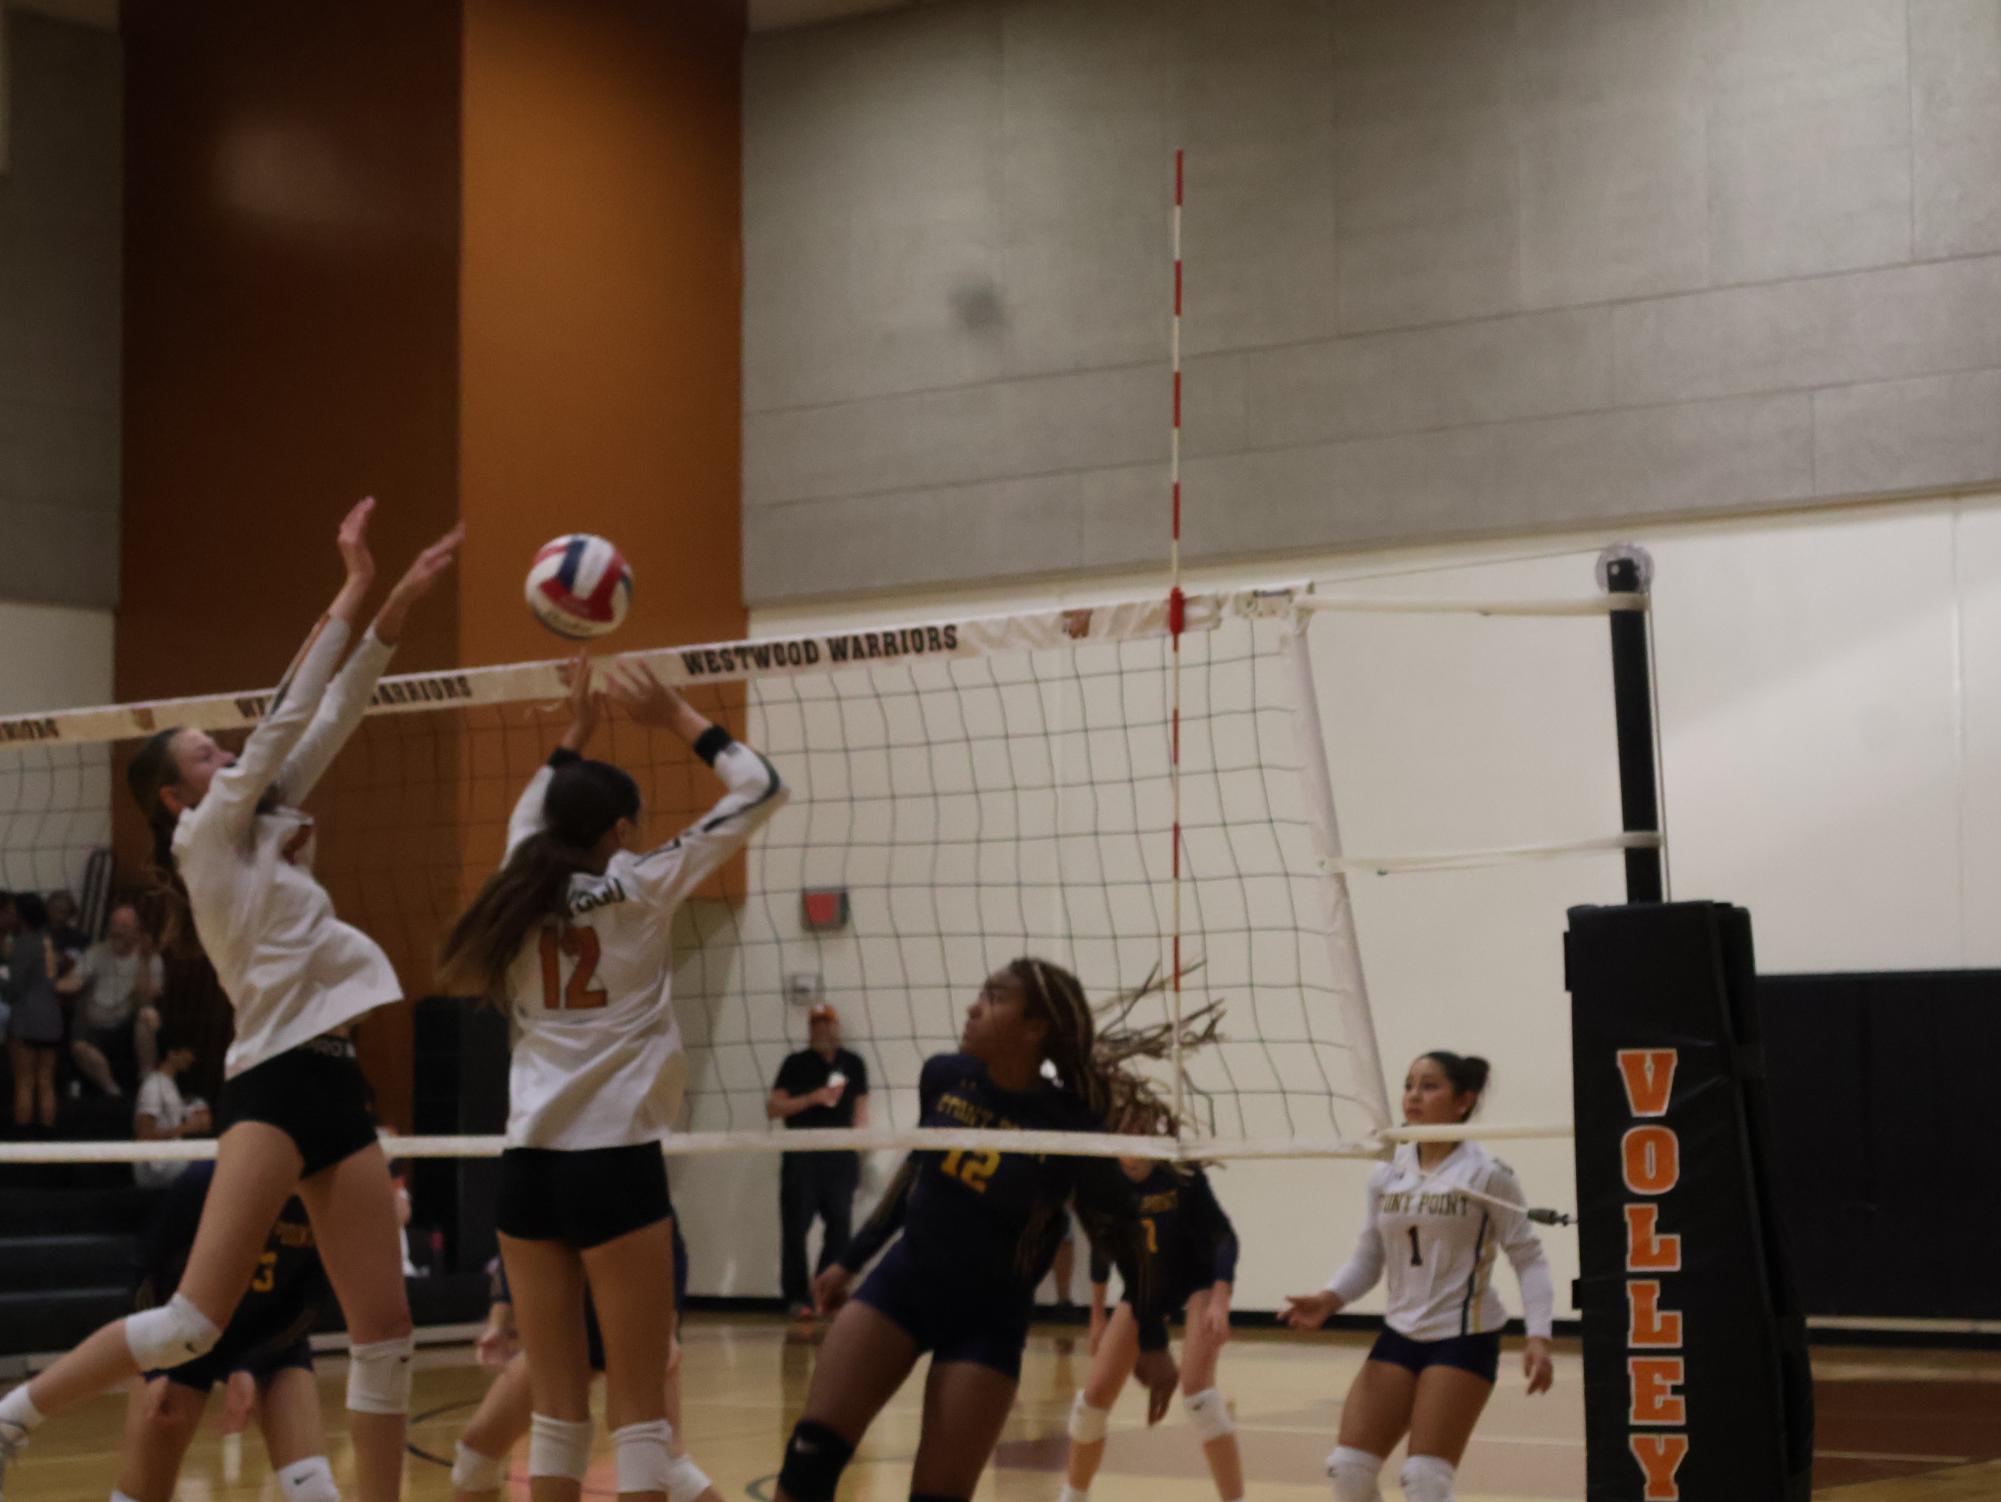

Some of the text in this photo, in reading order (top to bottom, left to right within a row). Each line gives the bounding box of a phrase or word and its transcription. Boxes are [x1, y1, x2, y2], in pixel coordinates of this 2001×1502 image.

[682, 623, 958, 676] WESTWOOD WARRIORS
[371, 675, 473, 705] ARRIORS
[538, 924, 609, 1010] 12
[940, 1147, 1002, 1195] 12
[1406, 1224, 1424, 1267] 1
